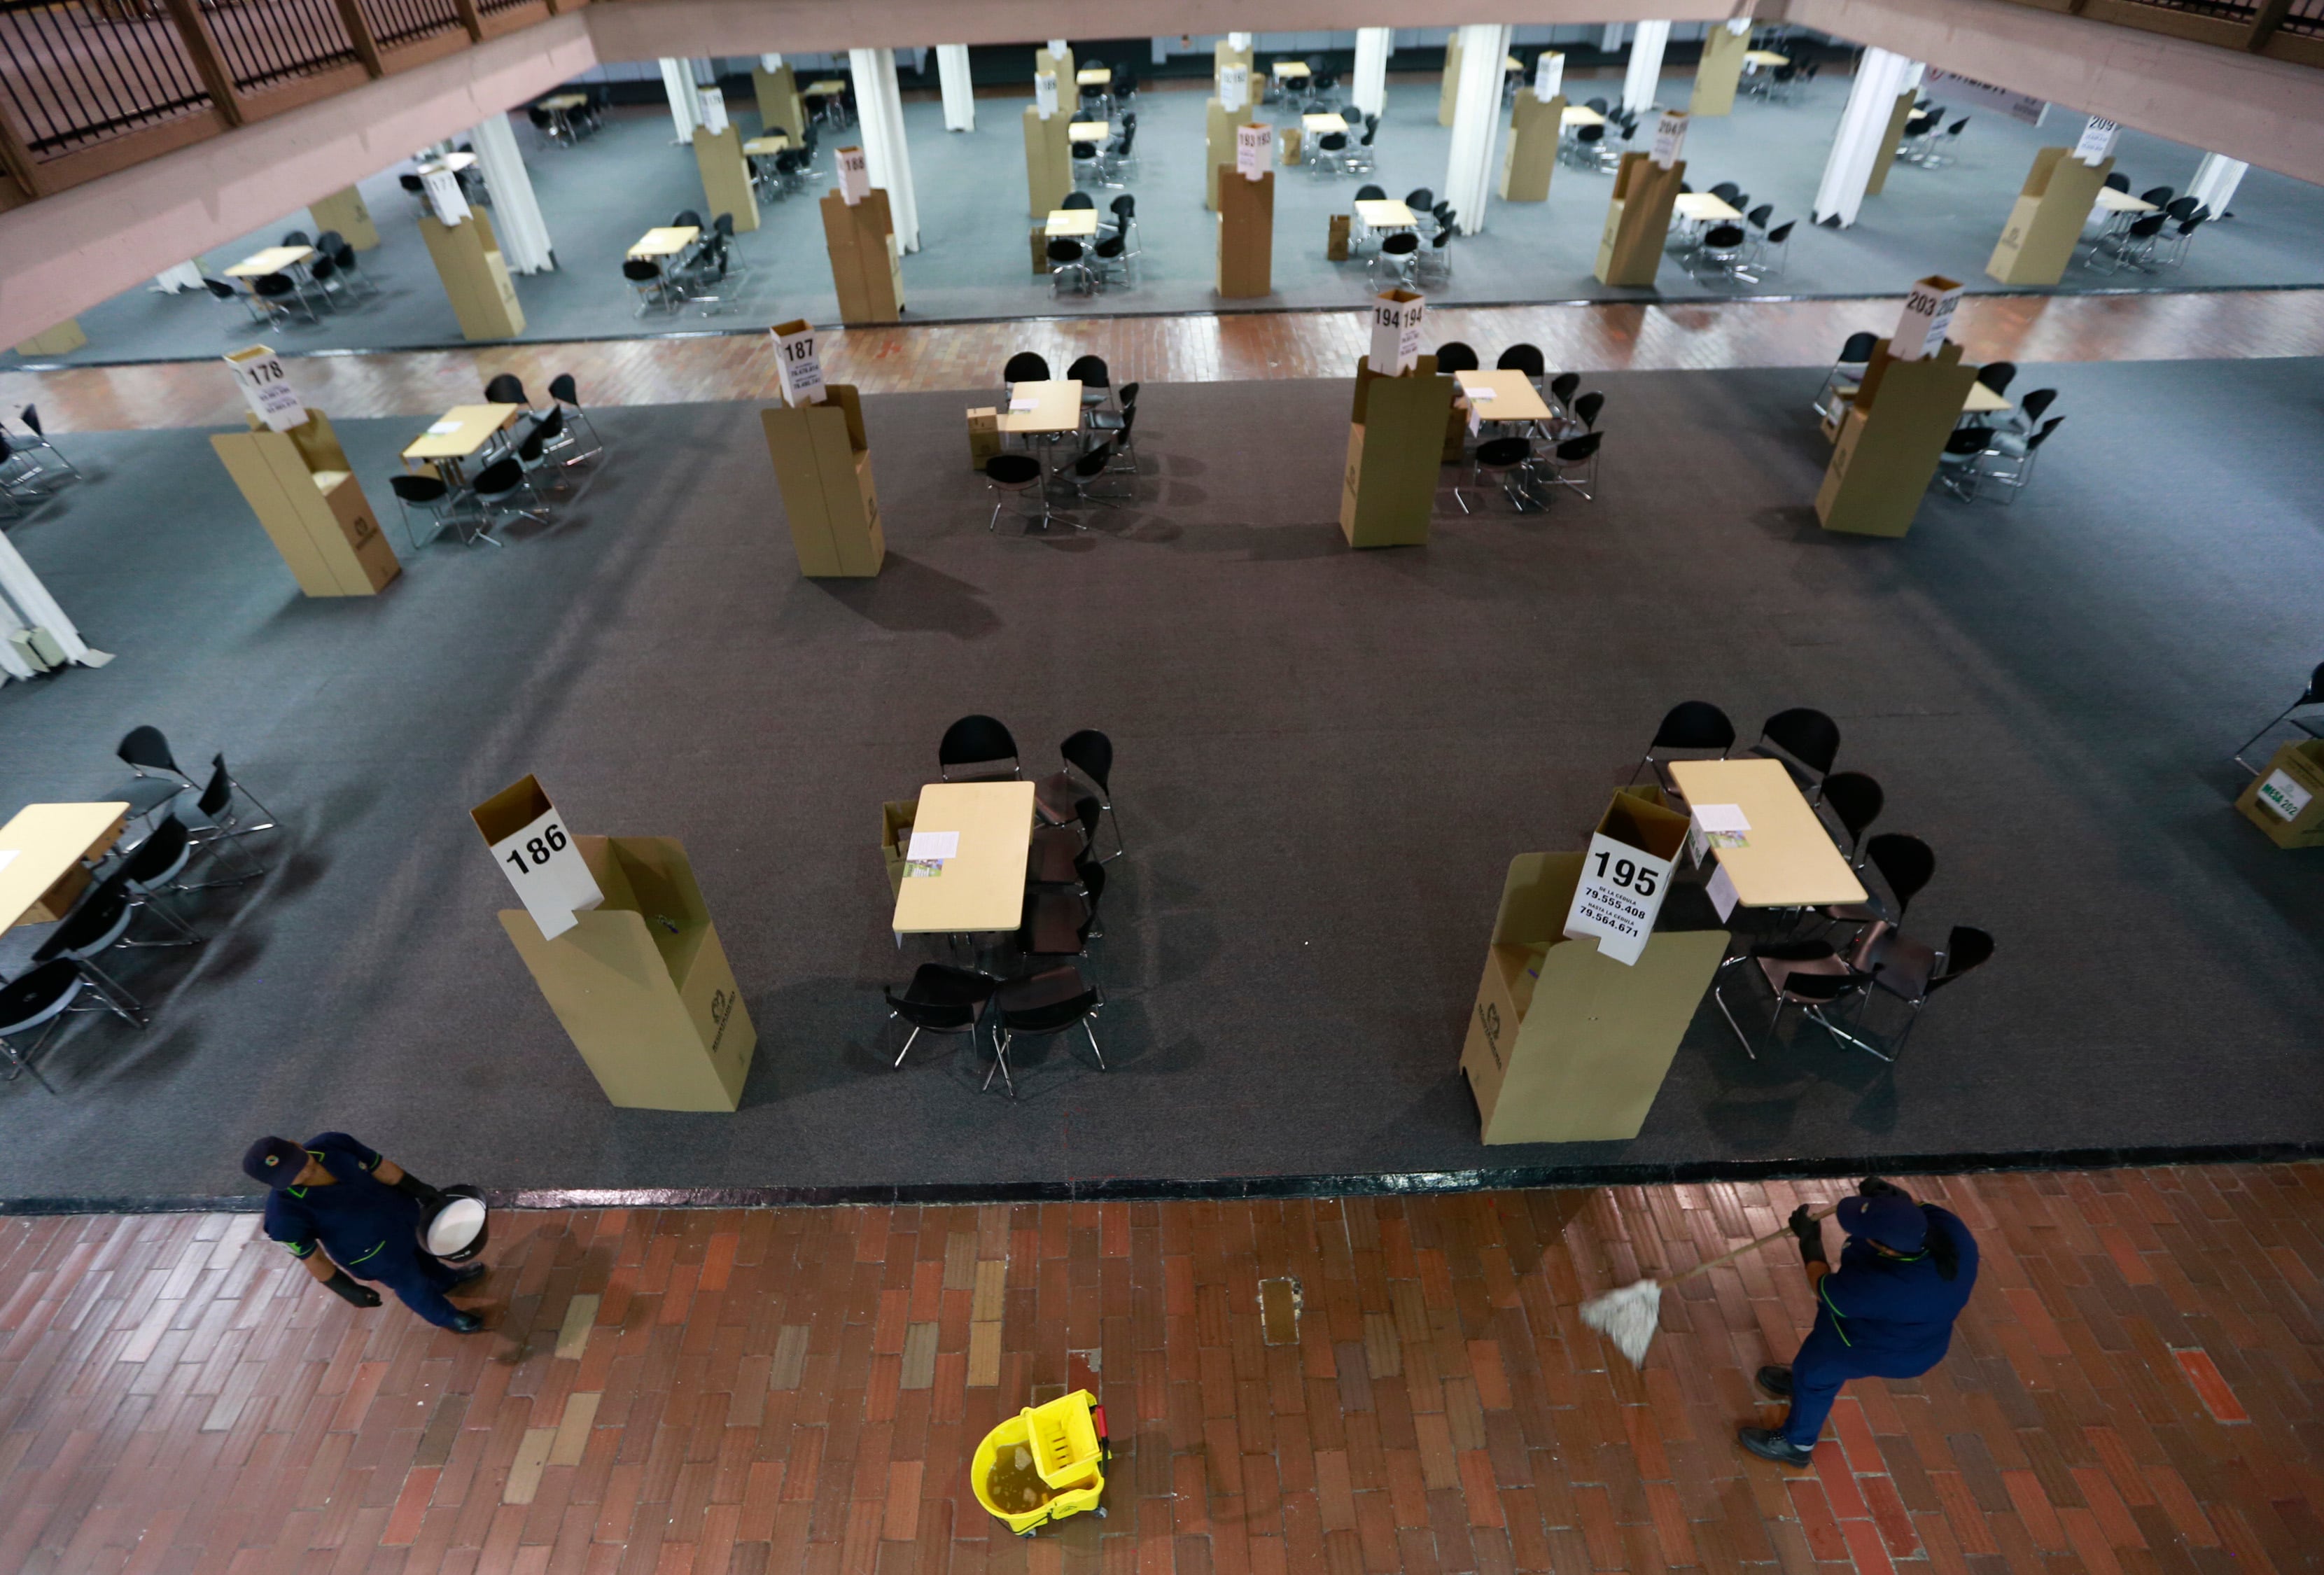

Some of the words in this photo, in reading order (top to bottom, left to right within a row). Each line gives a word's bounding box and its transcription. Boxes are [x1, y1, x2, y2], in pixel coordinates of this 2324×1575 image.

[1404, 306, 1422, 328] 194
[1905, 290, 1938, 317] 203
[1375, 307, 1400, 328] 194
[785, 337, 813, 362] 187
[248, 360, 284, 386] 178
[2261, 783, 2284, 804] MESA
[2281, 799, 2298, 816] 202
[506, 823, 567, 874] 186
[1595, 851, 1660, 897] 195
[1586, 887, 1646, 919] 79.555.408
[1588, 902, 1605, 913] HASTA
[1579, 905, 1639, 938] 79.564.671
